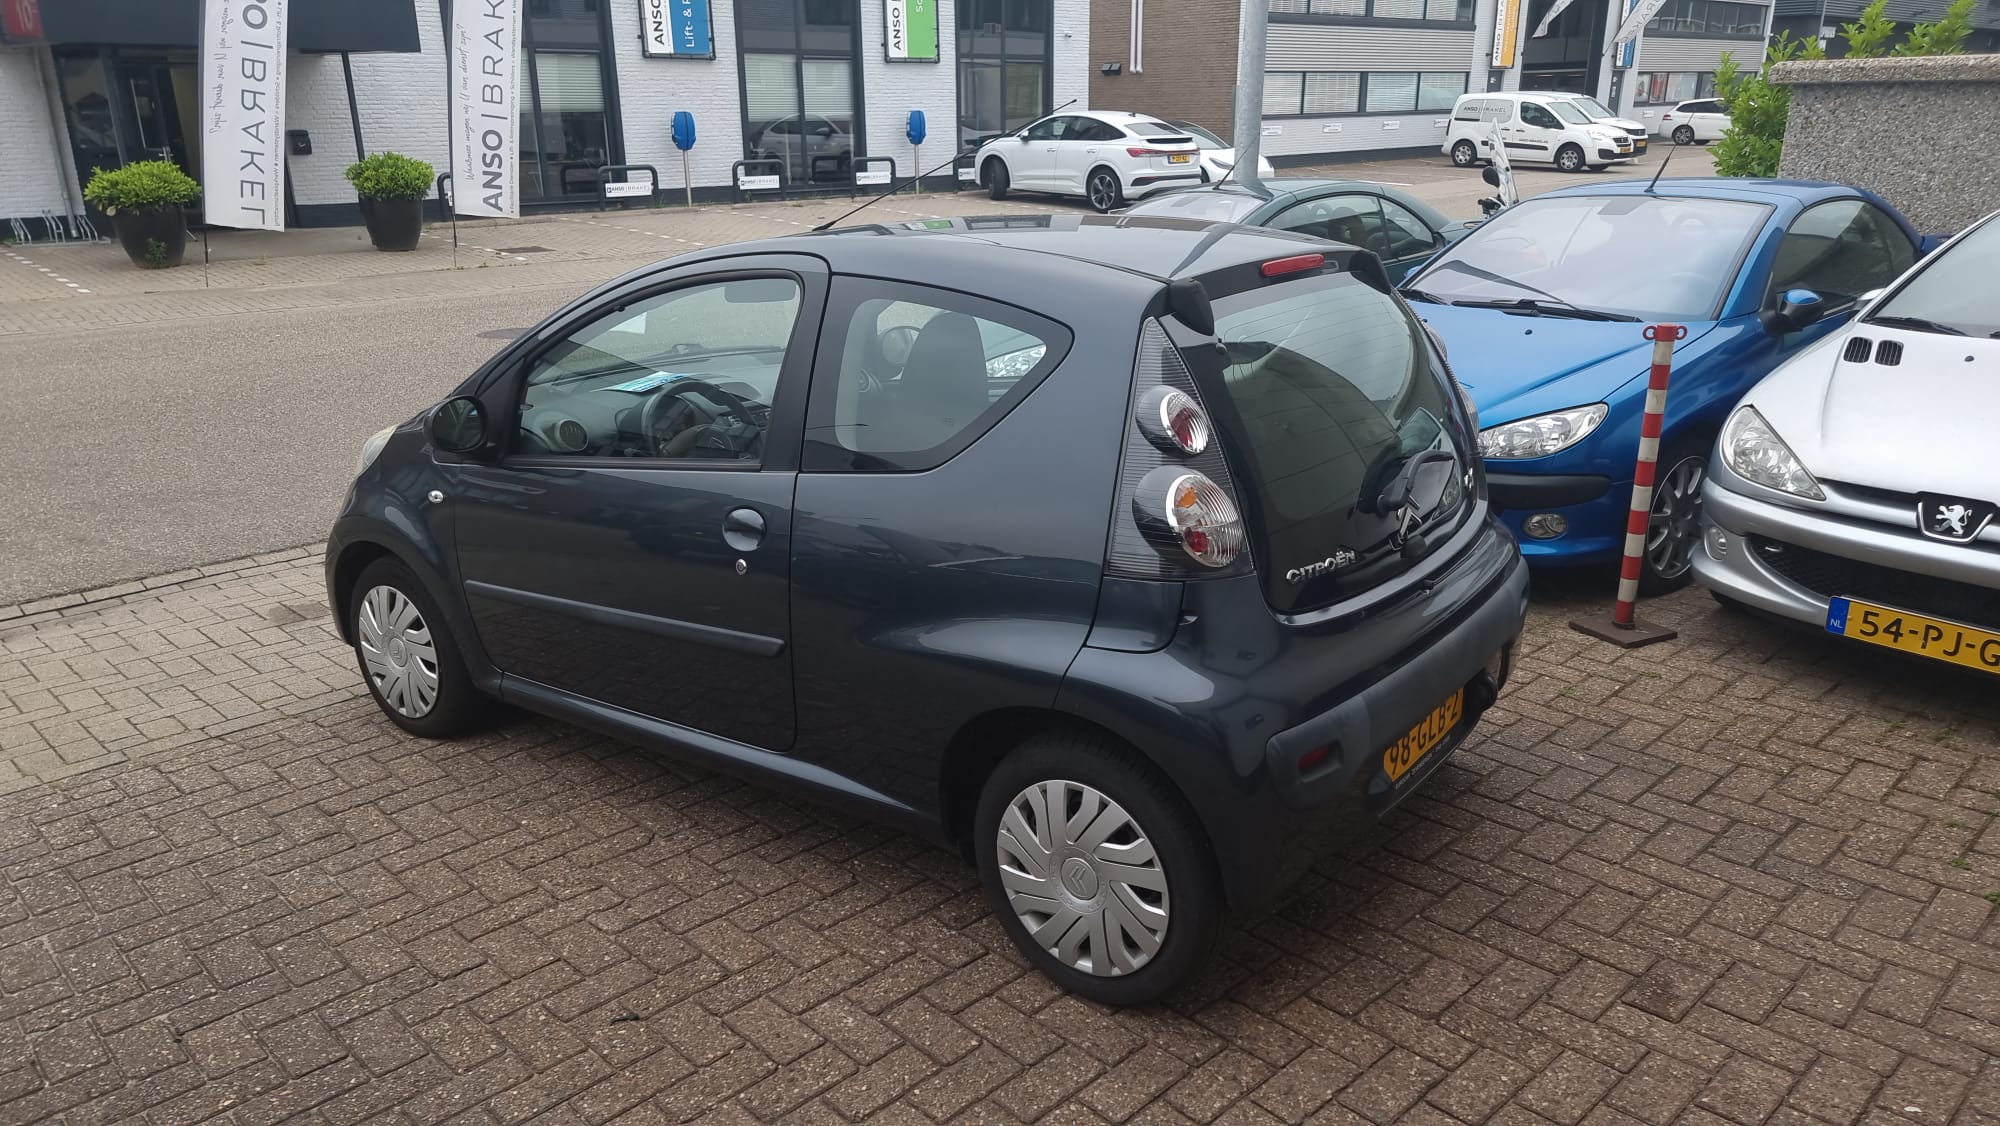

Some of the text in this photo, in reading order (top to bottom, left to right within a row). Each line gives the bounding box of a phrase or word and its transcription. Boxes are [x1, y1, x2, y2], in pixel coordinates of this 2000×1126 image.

[683, 8, 692, 17] &
[892, 7, 901, 50] ANSO
[684, 21, 694, 47] Lift-
[481, 129, 503, 212] ANSO
[1286, 551, 1356, 584] CITROËN
[1830, 618, 1843, 629] NL
[1859, 610, 2000, 667] 54-PJ-G
